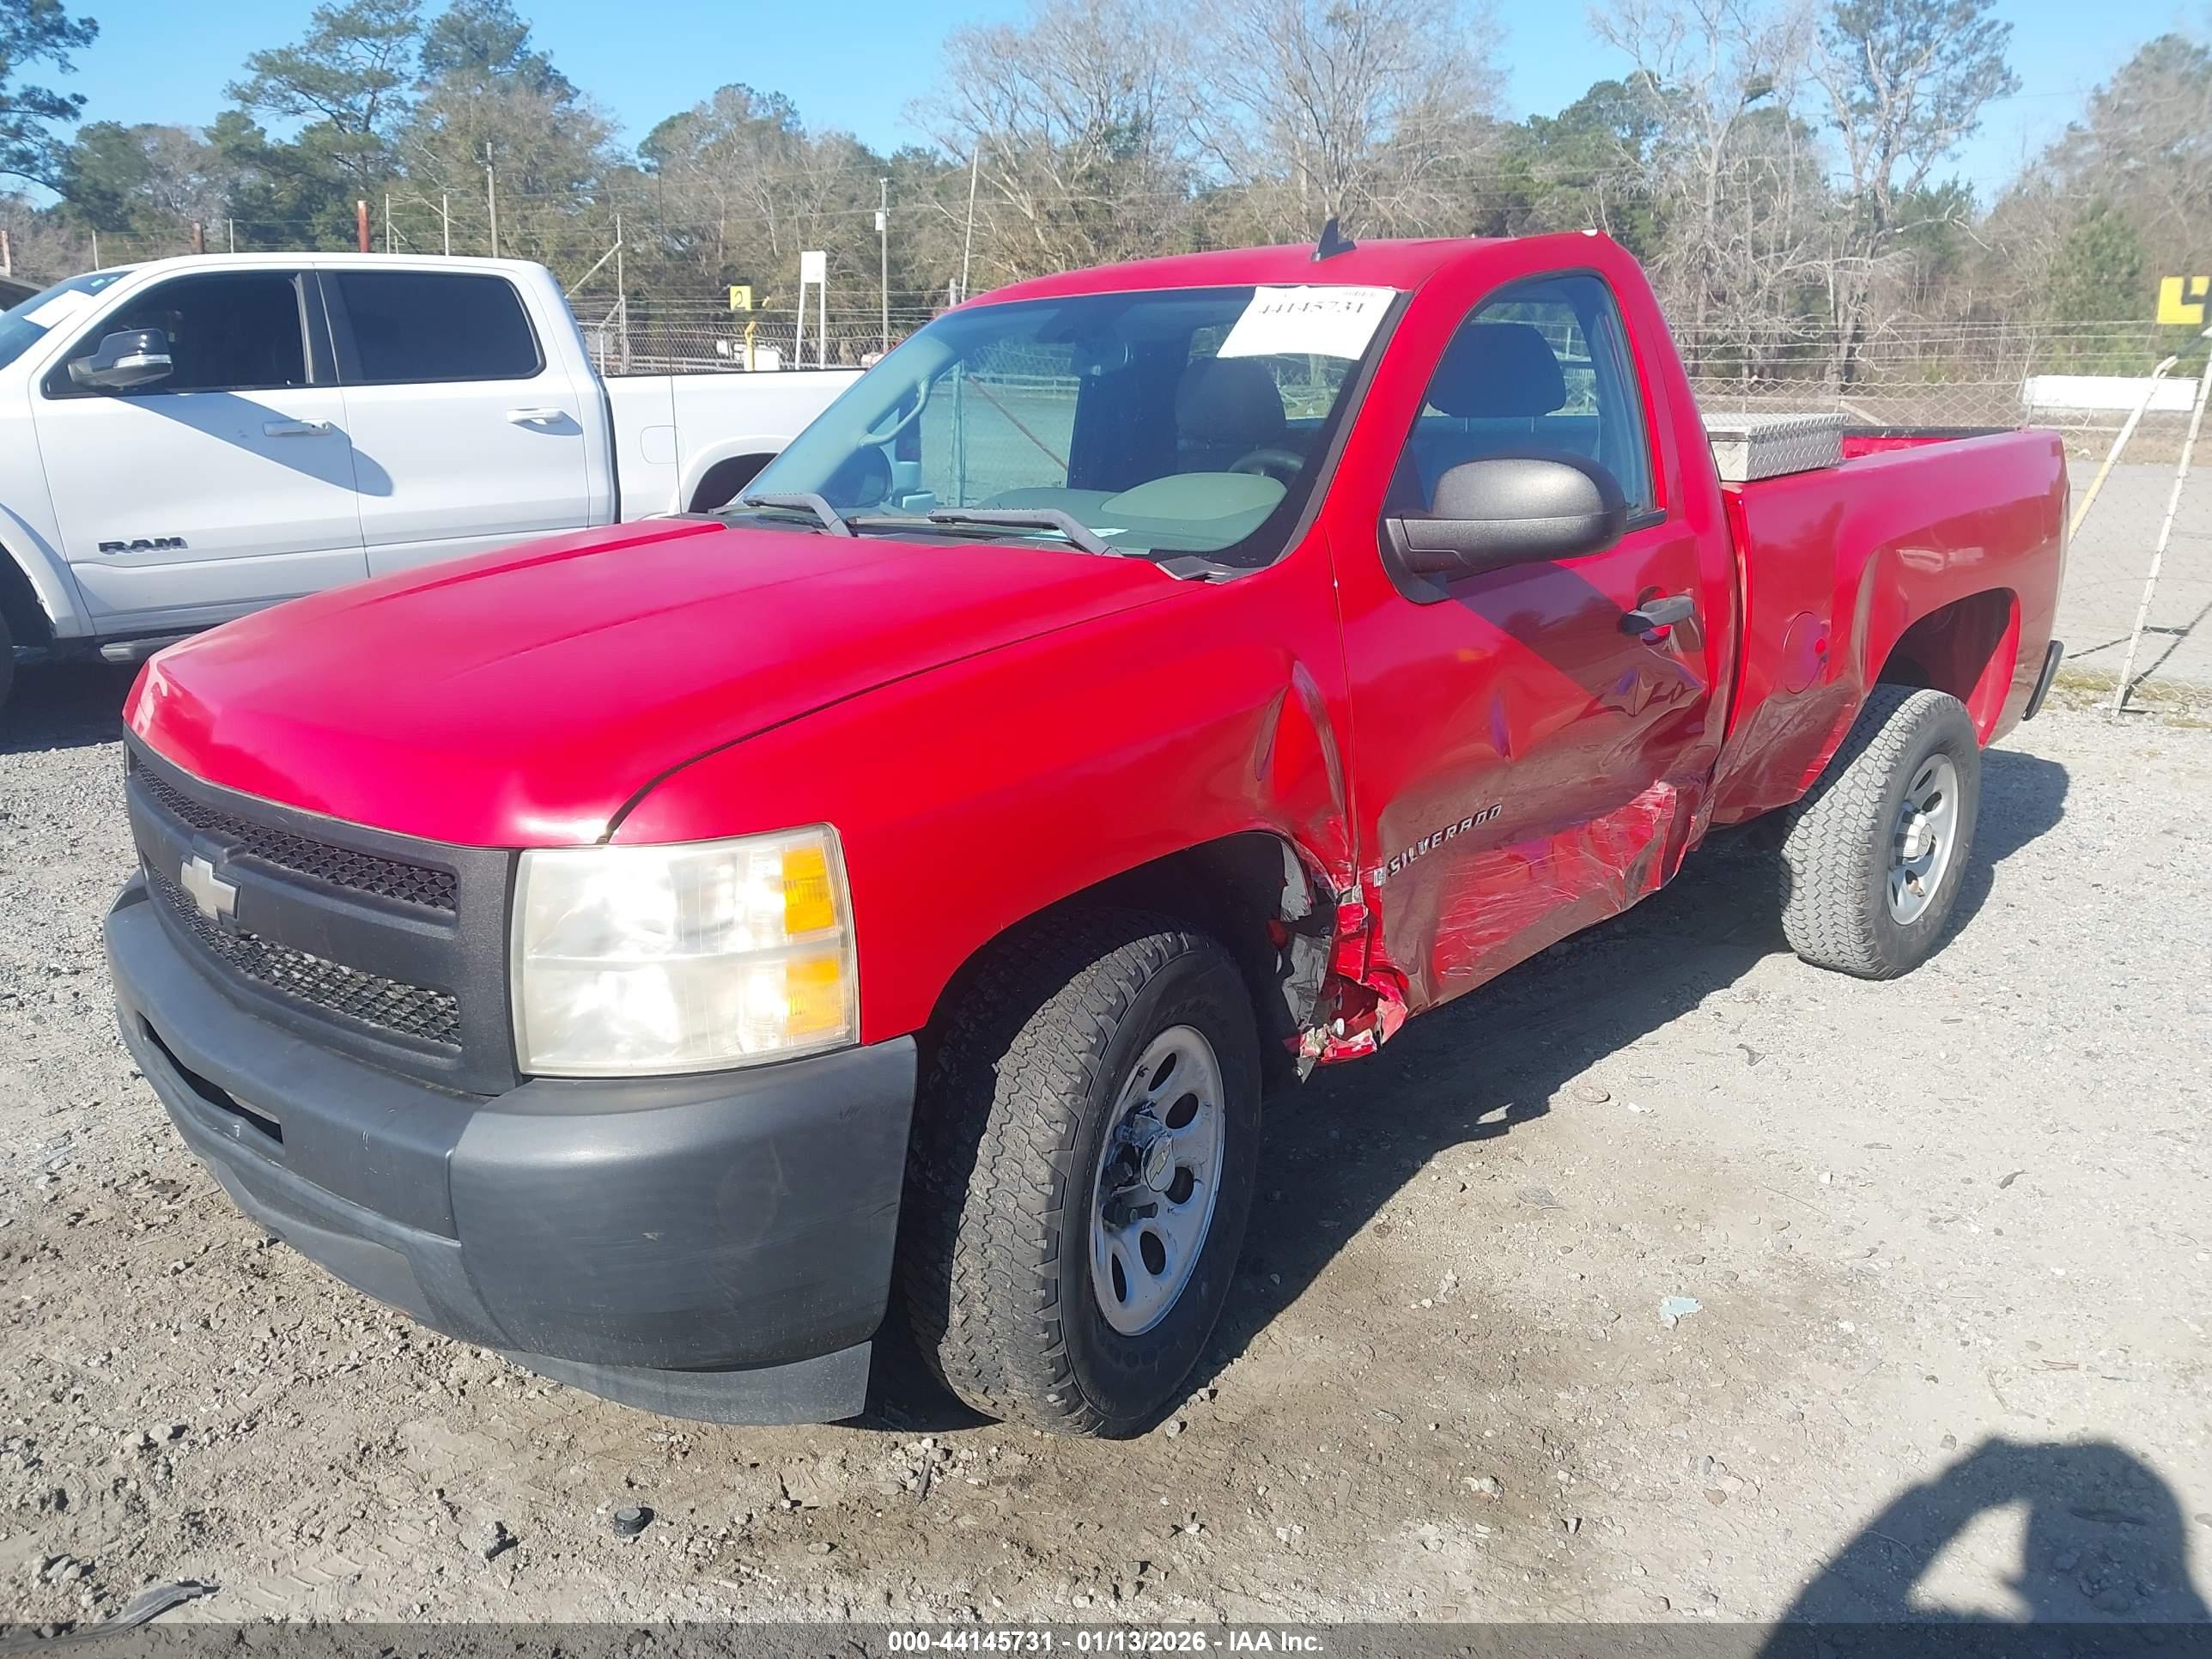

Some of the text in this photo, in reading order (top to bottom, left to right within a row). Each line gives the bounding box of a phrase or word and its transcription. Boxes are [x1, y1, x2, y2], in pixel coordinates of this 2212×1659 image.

[734, 290, 746, 310] 2
[98, 537, 188, 555] RAM
[1389, 804, 1503, 877] SILVERADO
